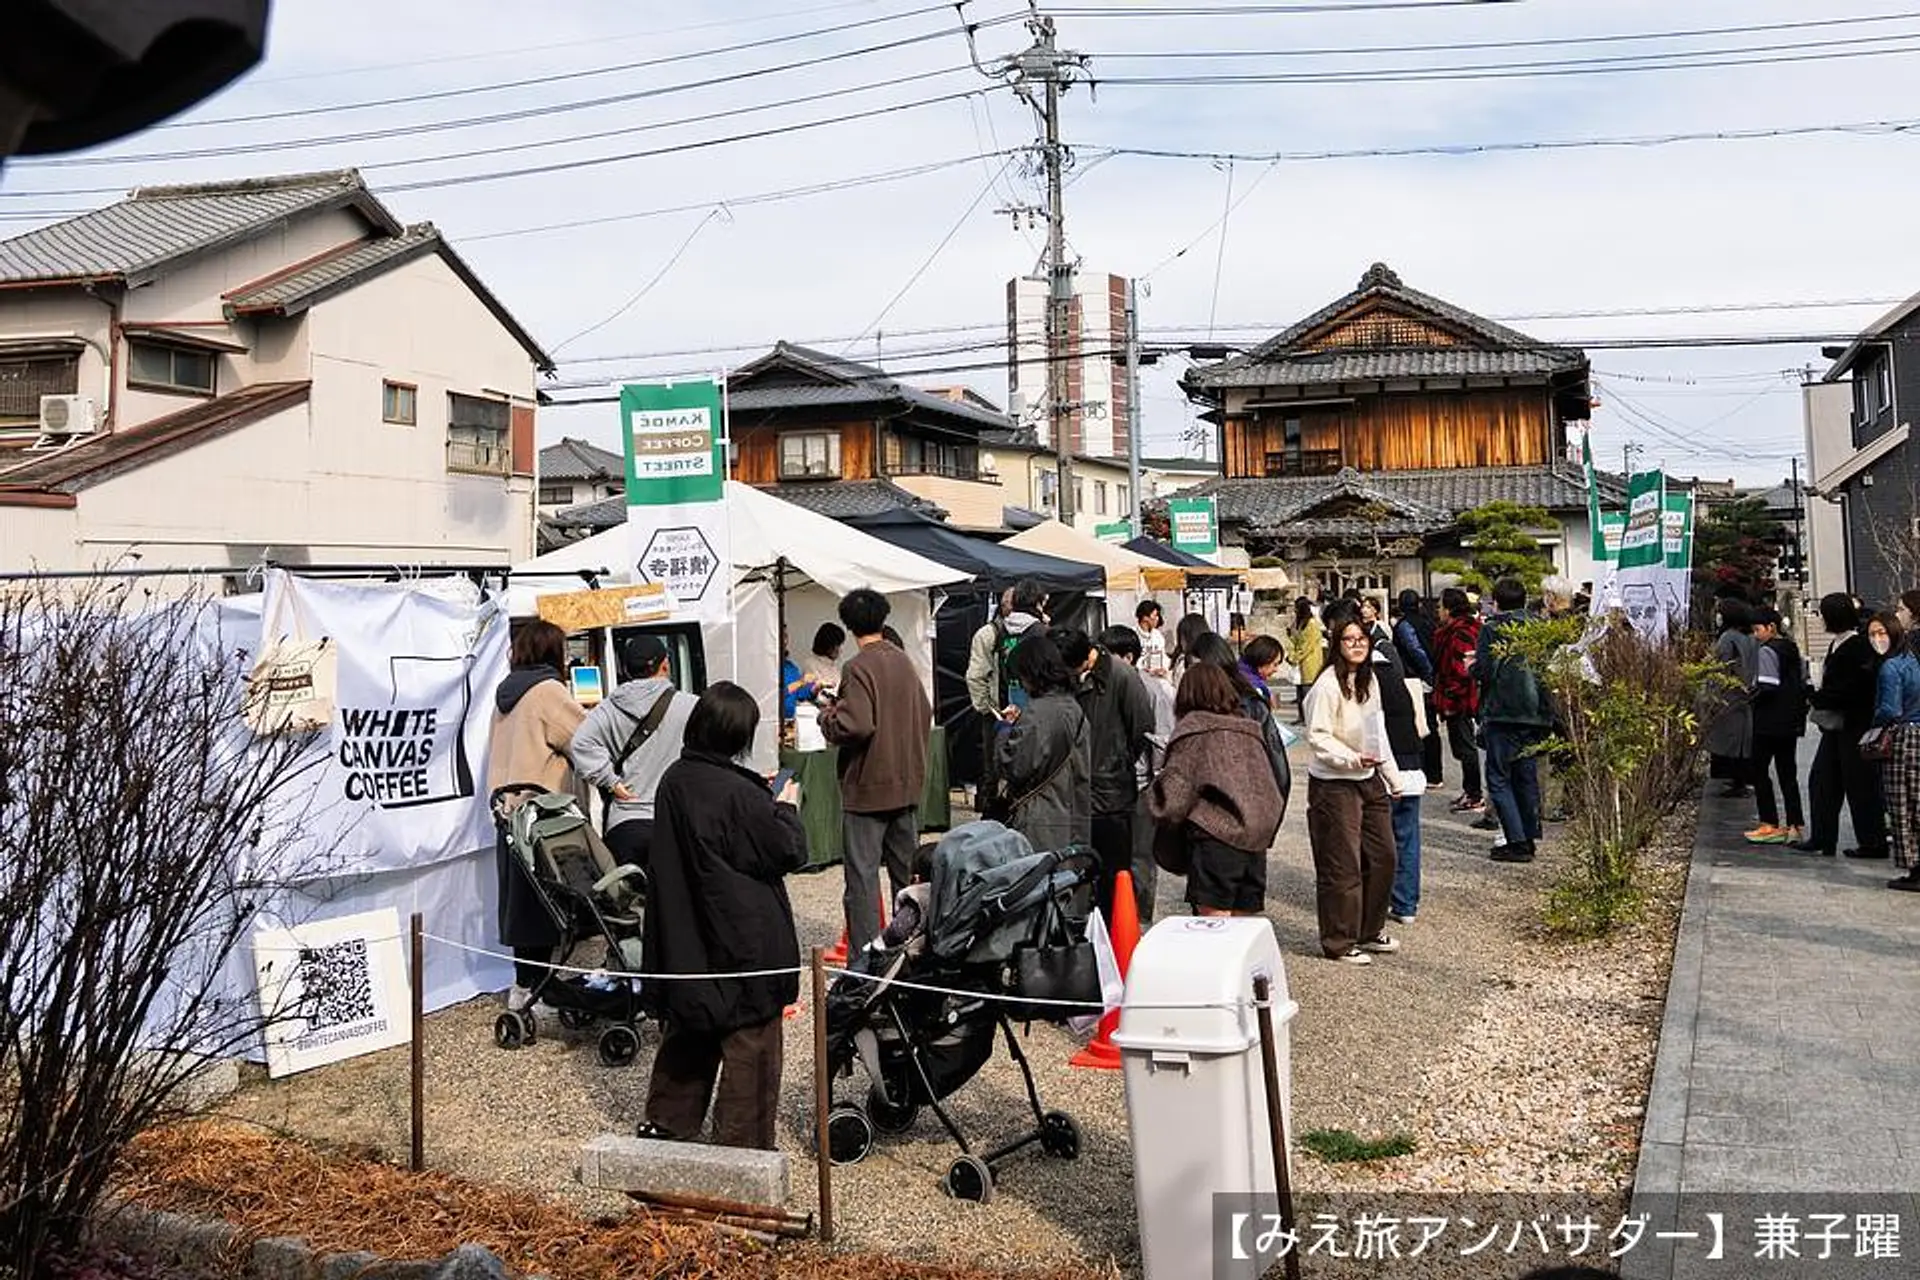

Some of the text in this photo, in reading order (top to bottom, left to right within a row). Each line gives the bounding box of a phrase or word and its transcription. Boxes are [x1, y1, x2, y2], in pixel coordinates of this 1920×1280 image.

[341, 708, 437, 737] WHITE
[340, 738, 433, 769] CANVAS
[344, 768, 429, 801] COFFEE
